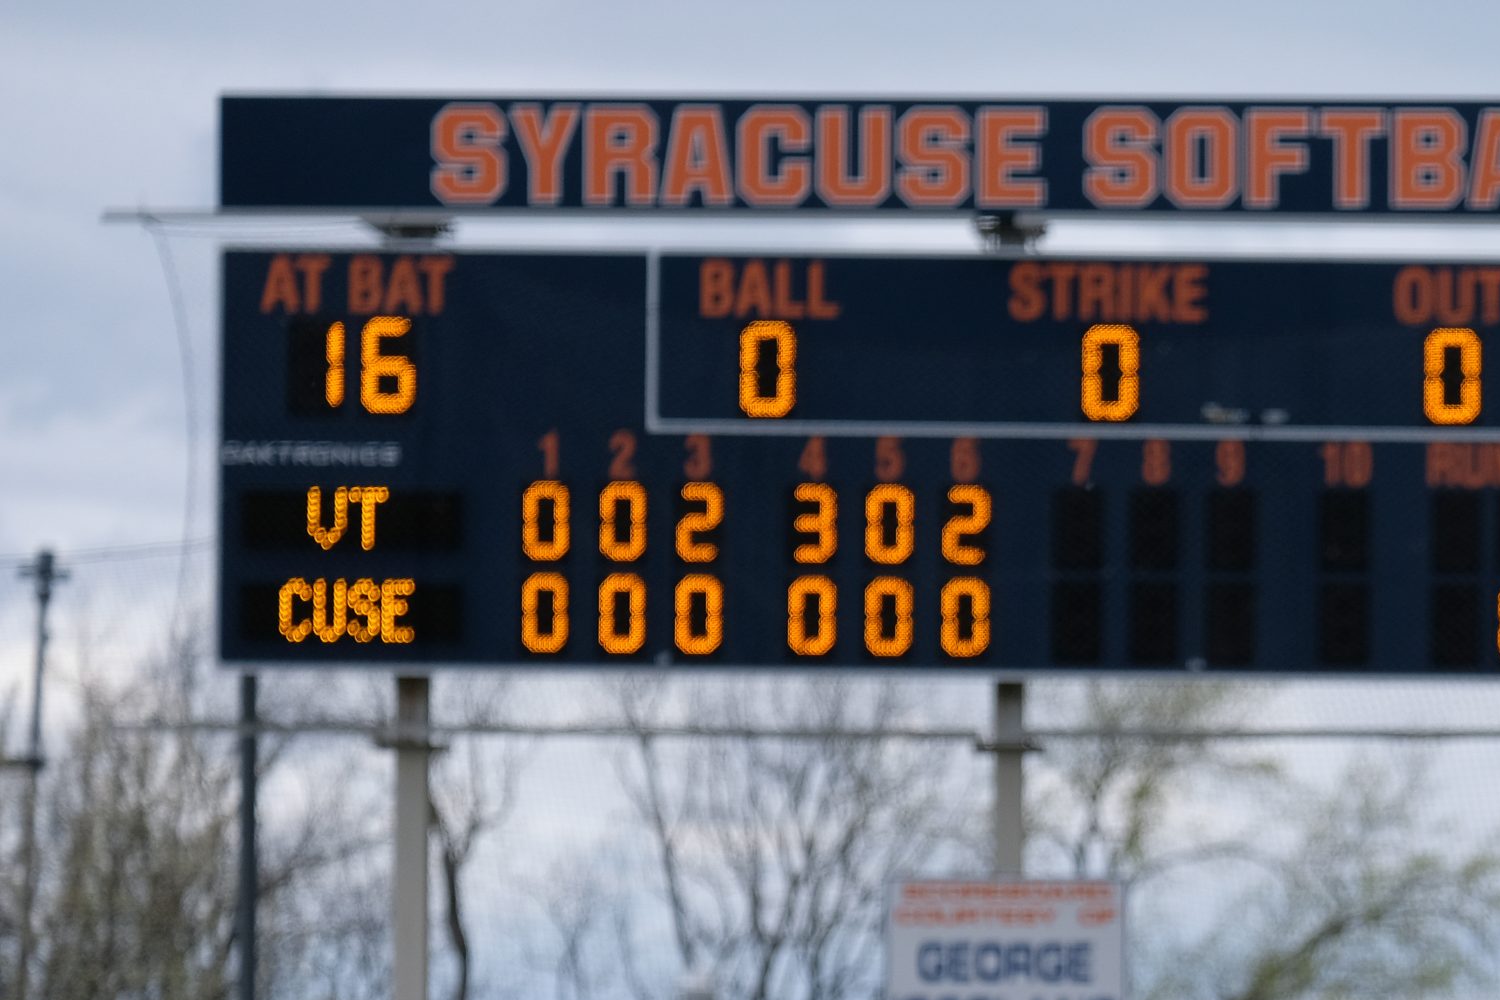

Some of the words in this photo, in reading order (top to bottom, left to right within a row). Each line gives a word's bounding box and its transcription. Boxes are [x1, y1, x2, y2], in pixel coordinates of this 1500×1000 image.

[430, 102, 1047, 207] SYRACUSE
[261, 256, 330, 312] AT
[348, 257, 453, 316] BAT
[701, 261, 838, 319] BALL
[1009, 262, 1208, 324] STRIKE
[325, 316, 417, 414] 16
[739, 320, 796, 418] 0
[1081, 324, 1139, 421] 0
[1424, 328, 1482, 424] 0
[535, 429, 560, 478] 1
[609, 430, 636, 478] 2
[684, 433, 711, 480] 3
[799, 435, 826, 480] 4
[875, 435, 904, 481] 5
[951, 436, 980, 482] 6
[1070, 438, 1096, 484] 7
[1143, 438, 1170, 485] 8
[1216, 439, 1245, 486] 9
[1322, 441, 1373, 487] 10
[307, 486, 389, 551] VT
[523, 480, 570, 561] 0
[599, 481, 646, 561] 0
[675, 483, 722, 562] 2
[794, 483, 837, 563] 3
[865, 484, 914, 564] 0
[941, 486, 991, 565] 2
[278, 577, 415, 644] CUSE
[521, 573, 569, 653] 0
[598, 573, 646, 654] 0
[674, 575, 723, 655] 0
[787, 576, 837, 656] 0
[864, 578, 913, 657] 0
[940, 578, 990, 657] 0
[917, 942, 1091, 984] GEORGE
